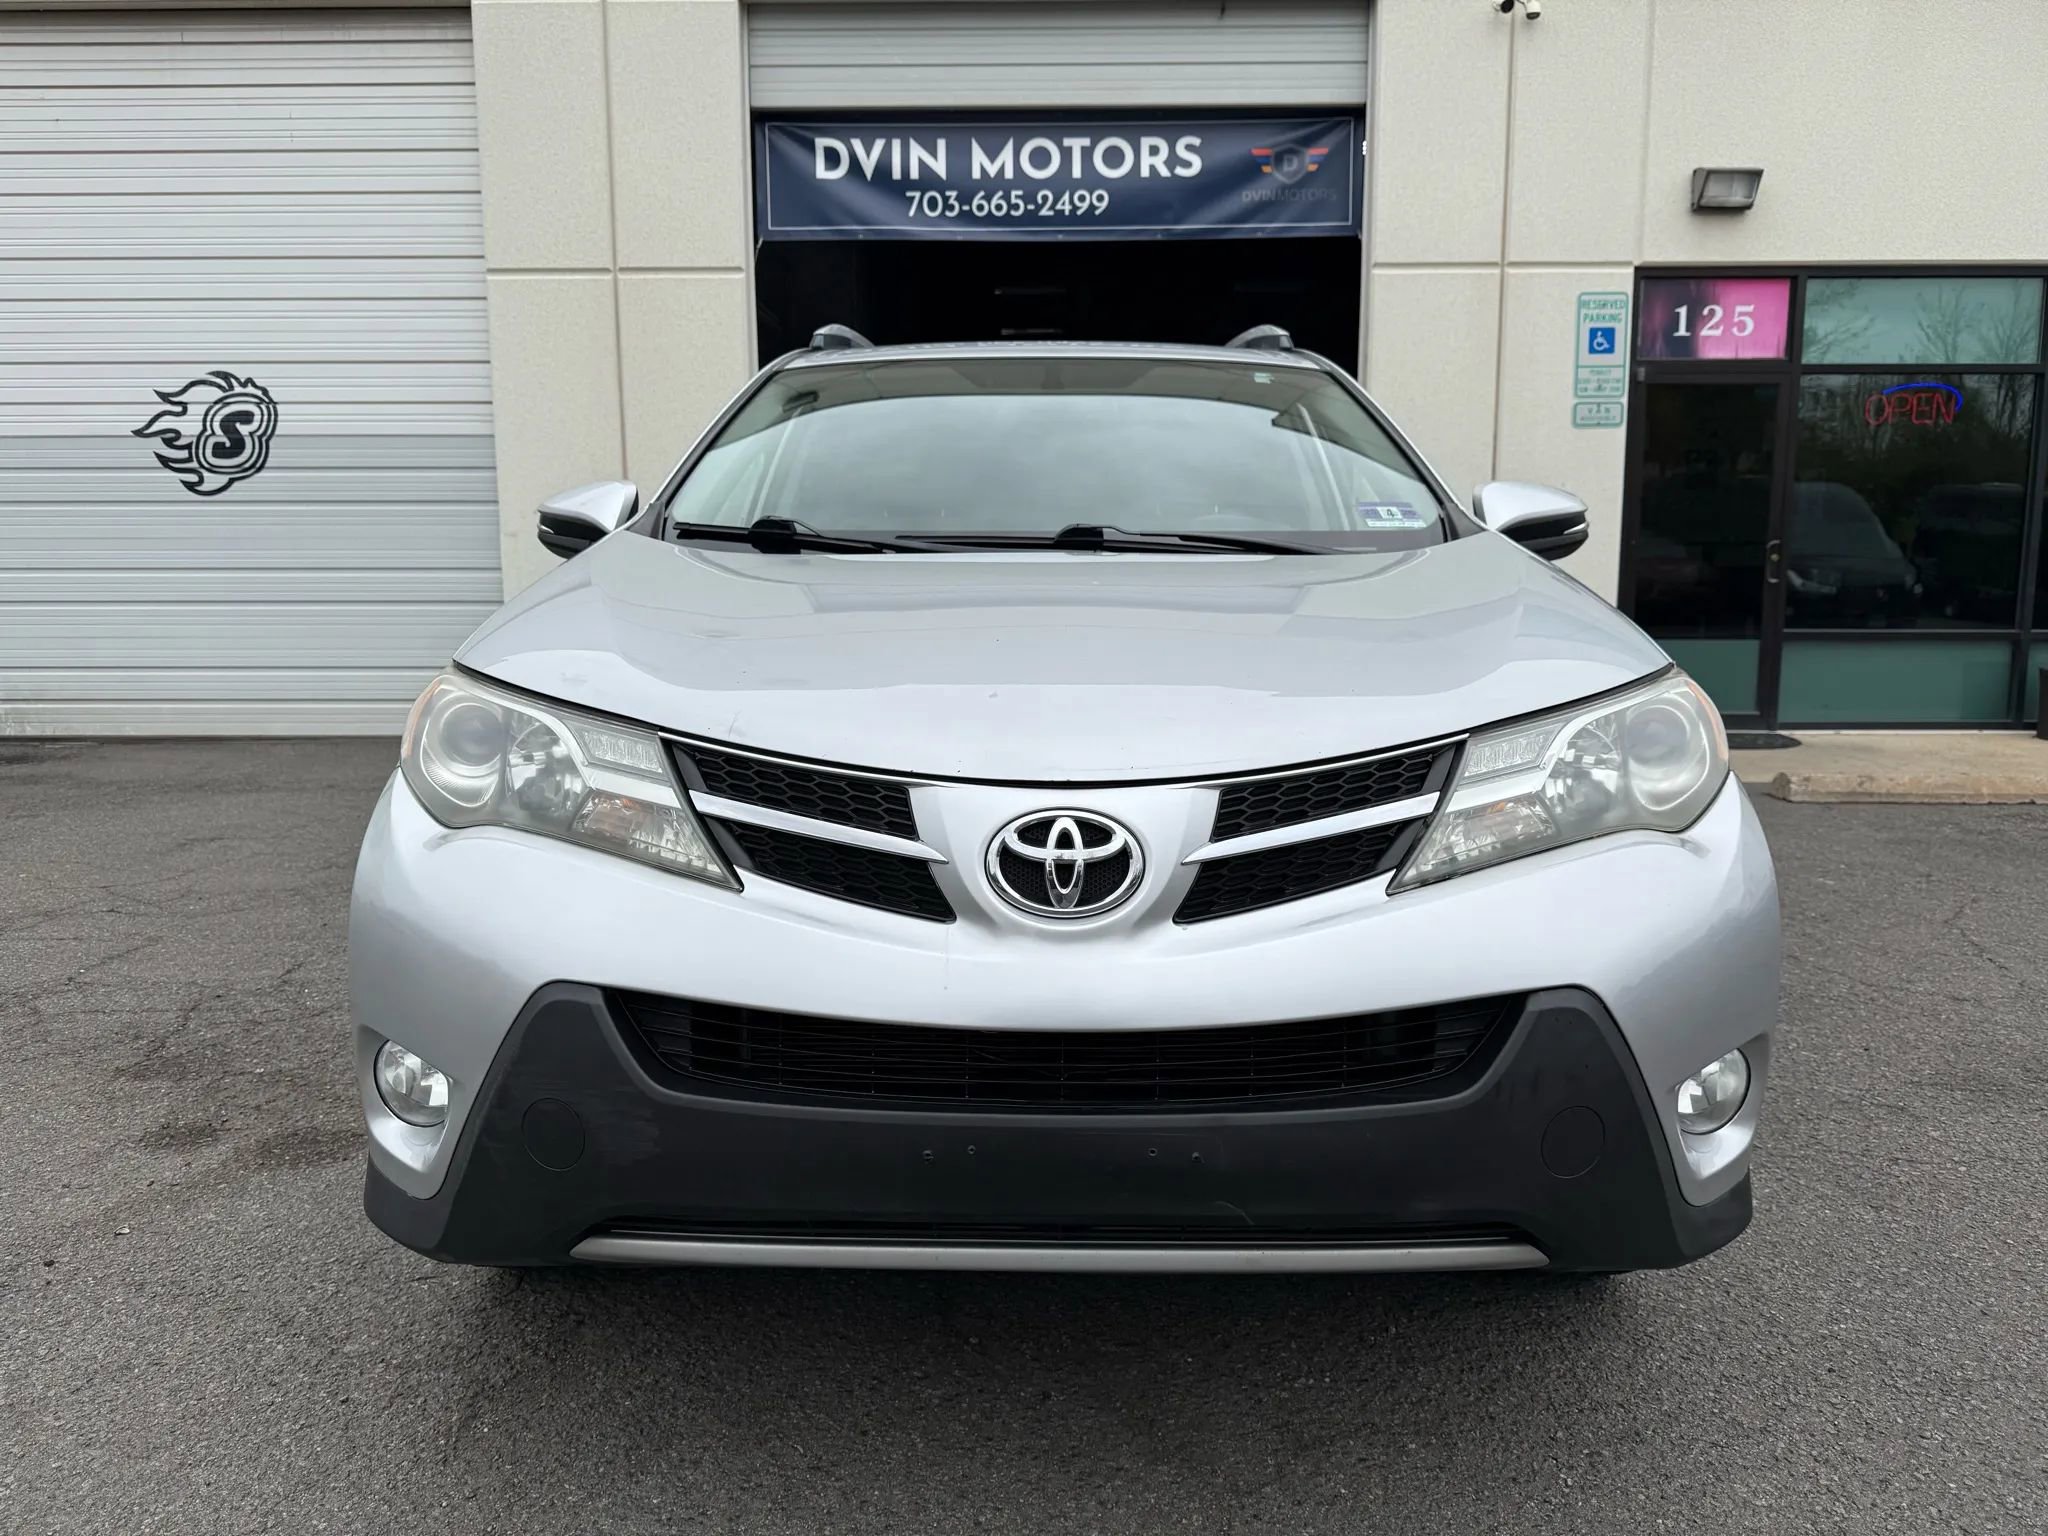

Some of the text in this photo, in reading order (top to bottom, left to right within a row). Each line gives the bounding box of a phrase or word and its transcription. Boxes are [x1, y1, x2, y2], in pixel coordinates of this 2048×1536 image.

[814, 136, 1203, 180] DVIN MOTORS
[905, 190, 1110, 218] 703-665-2499
[1672, 304, 1755, 337] 125
[1865, 392, 1957, 426] OPEN
